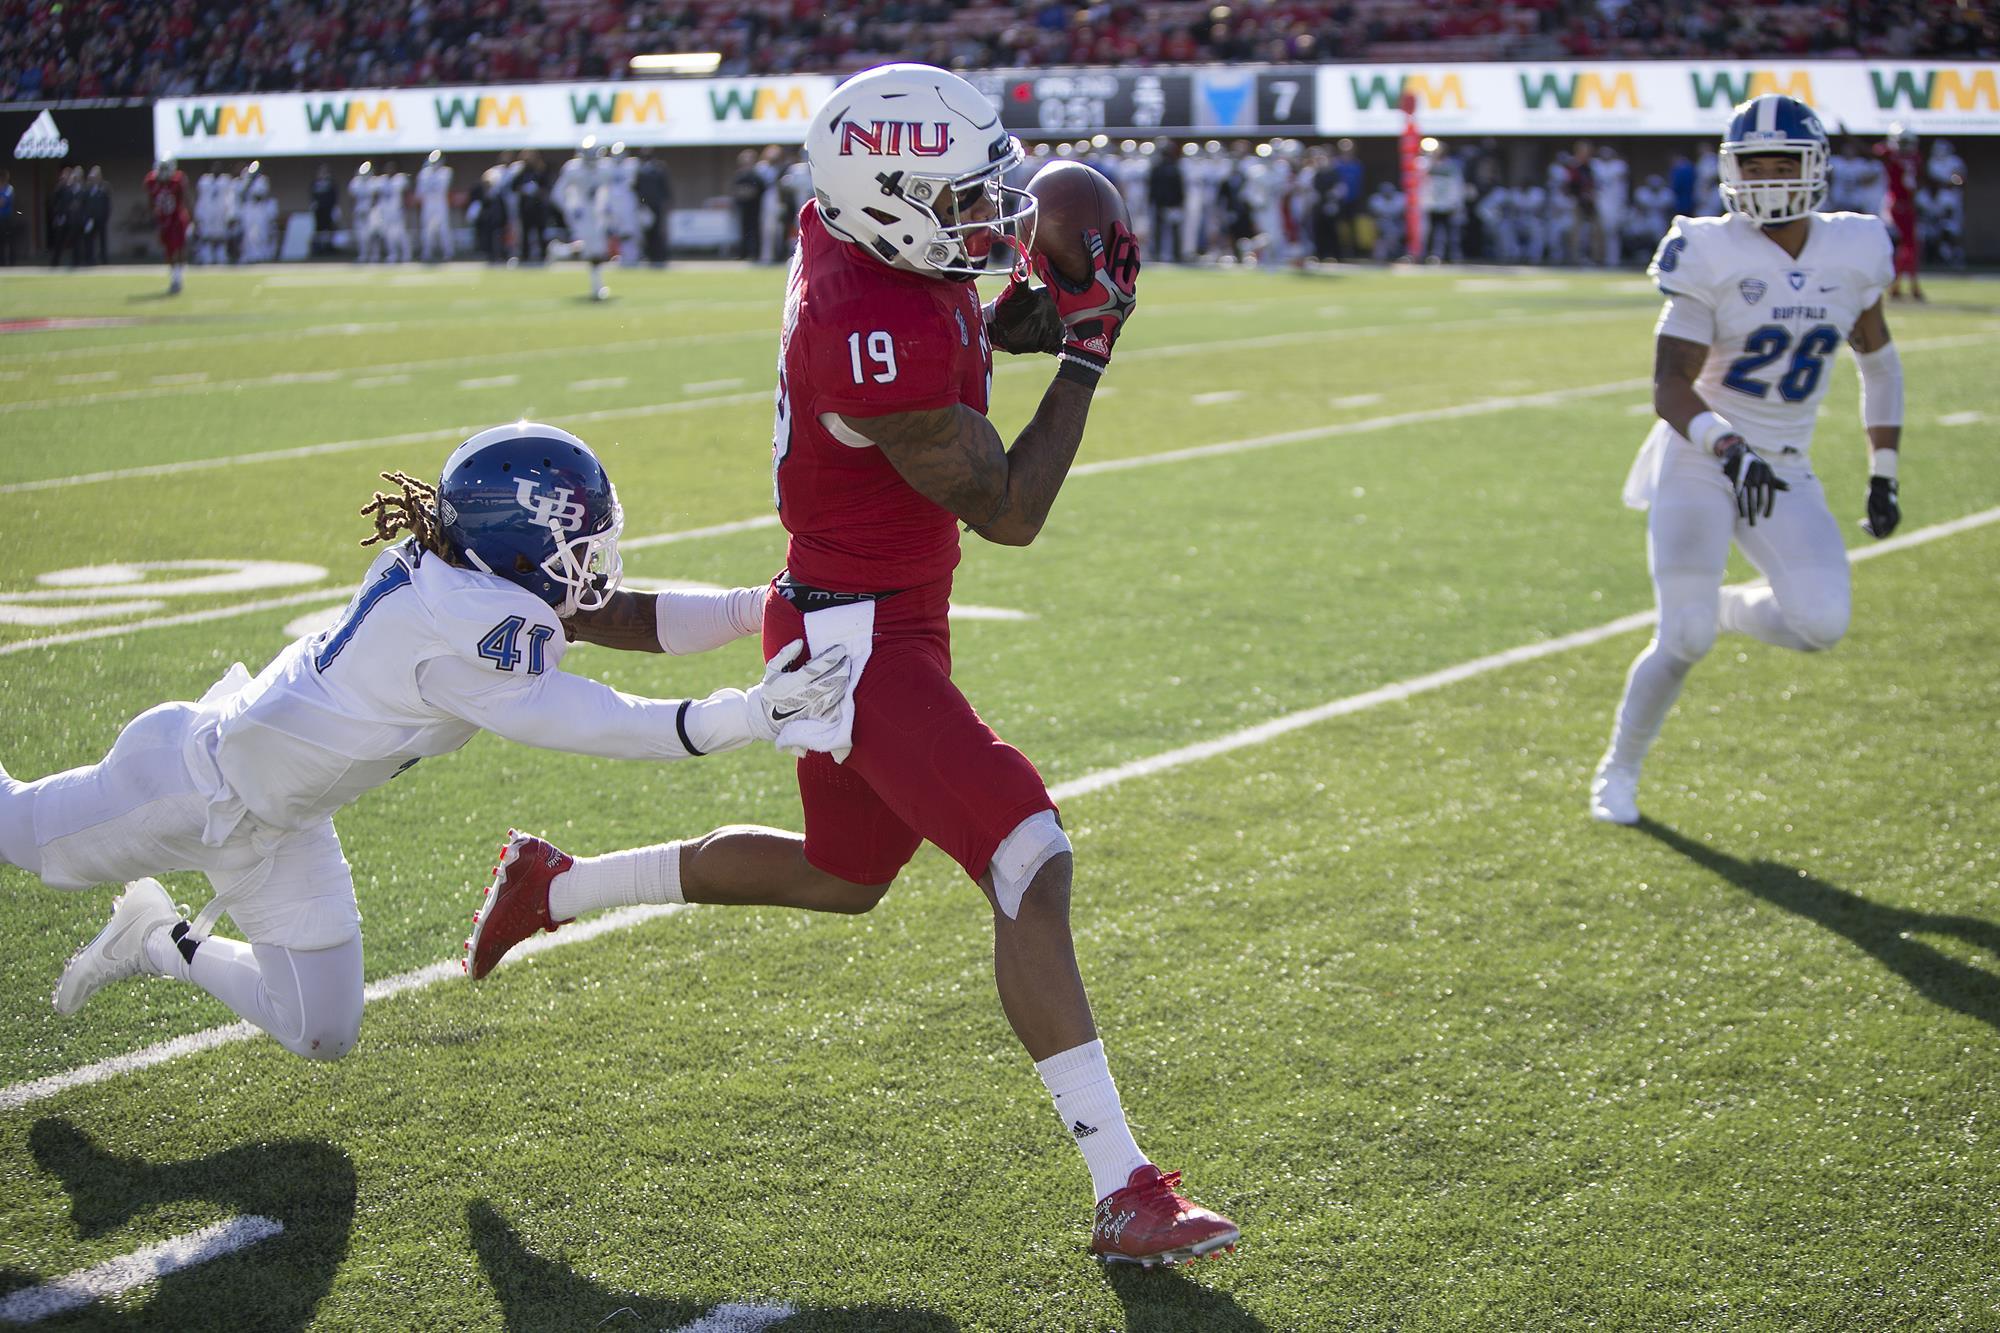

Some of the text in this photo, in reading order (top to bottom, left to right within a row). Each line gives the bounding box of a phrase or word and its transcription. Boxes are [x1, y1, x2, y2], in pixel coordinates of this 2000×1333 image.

[571, 92, 665, 124] WM
[711, 89, 808, 120] WM
[1270, 80, 1300, 121] 7
[1351, 74, 1465, 109] WM
[1522, 73, 1639, 109] WM
[1872, 70, 2000, 111] WM
[178, 105, 264, 136] WM
[306, 101, 395, 132] WM
[437, 97, 526, 128] WM
[839, 120, 950, 157] NIU
[1772, 306, 1828, 320] BUFFALO
[847, 329, 898, 385] 19
[1722, 323, 1843, 403] 26
[476, 614, 556, 676] 41
